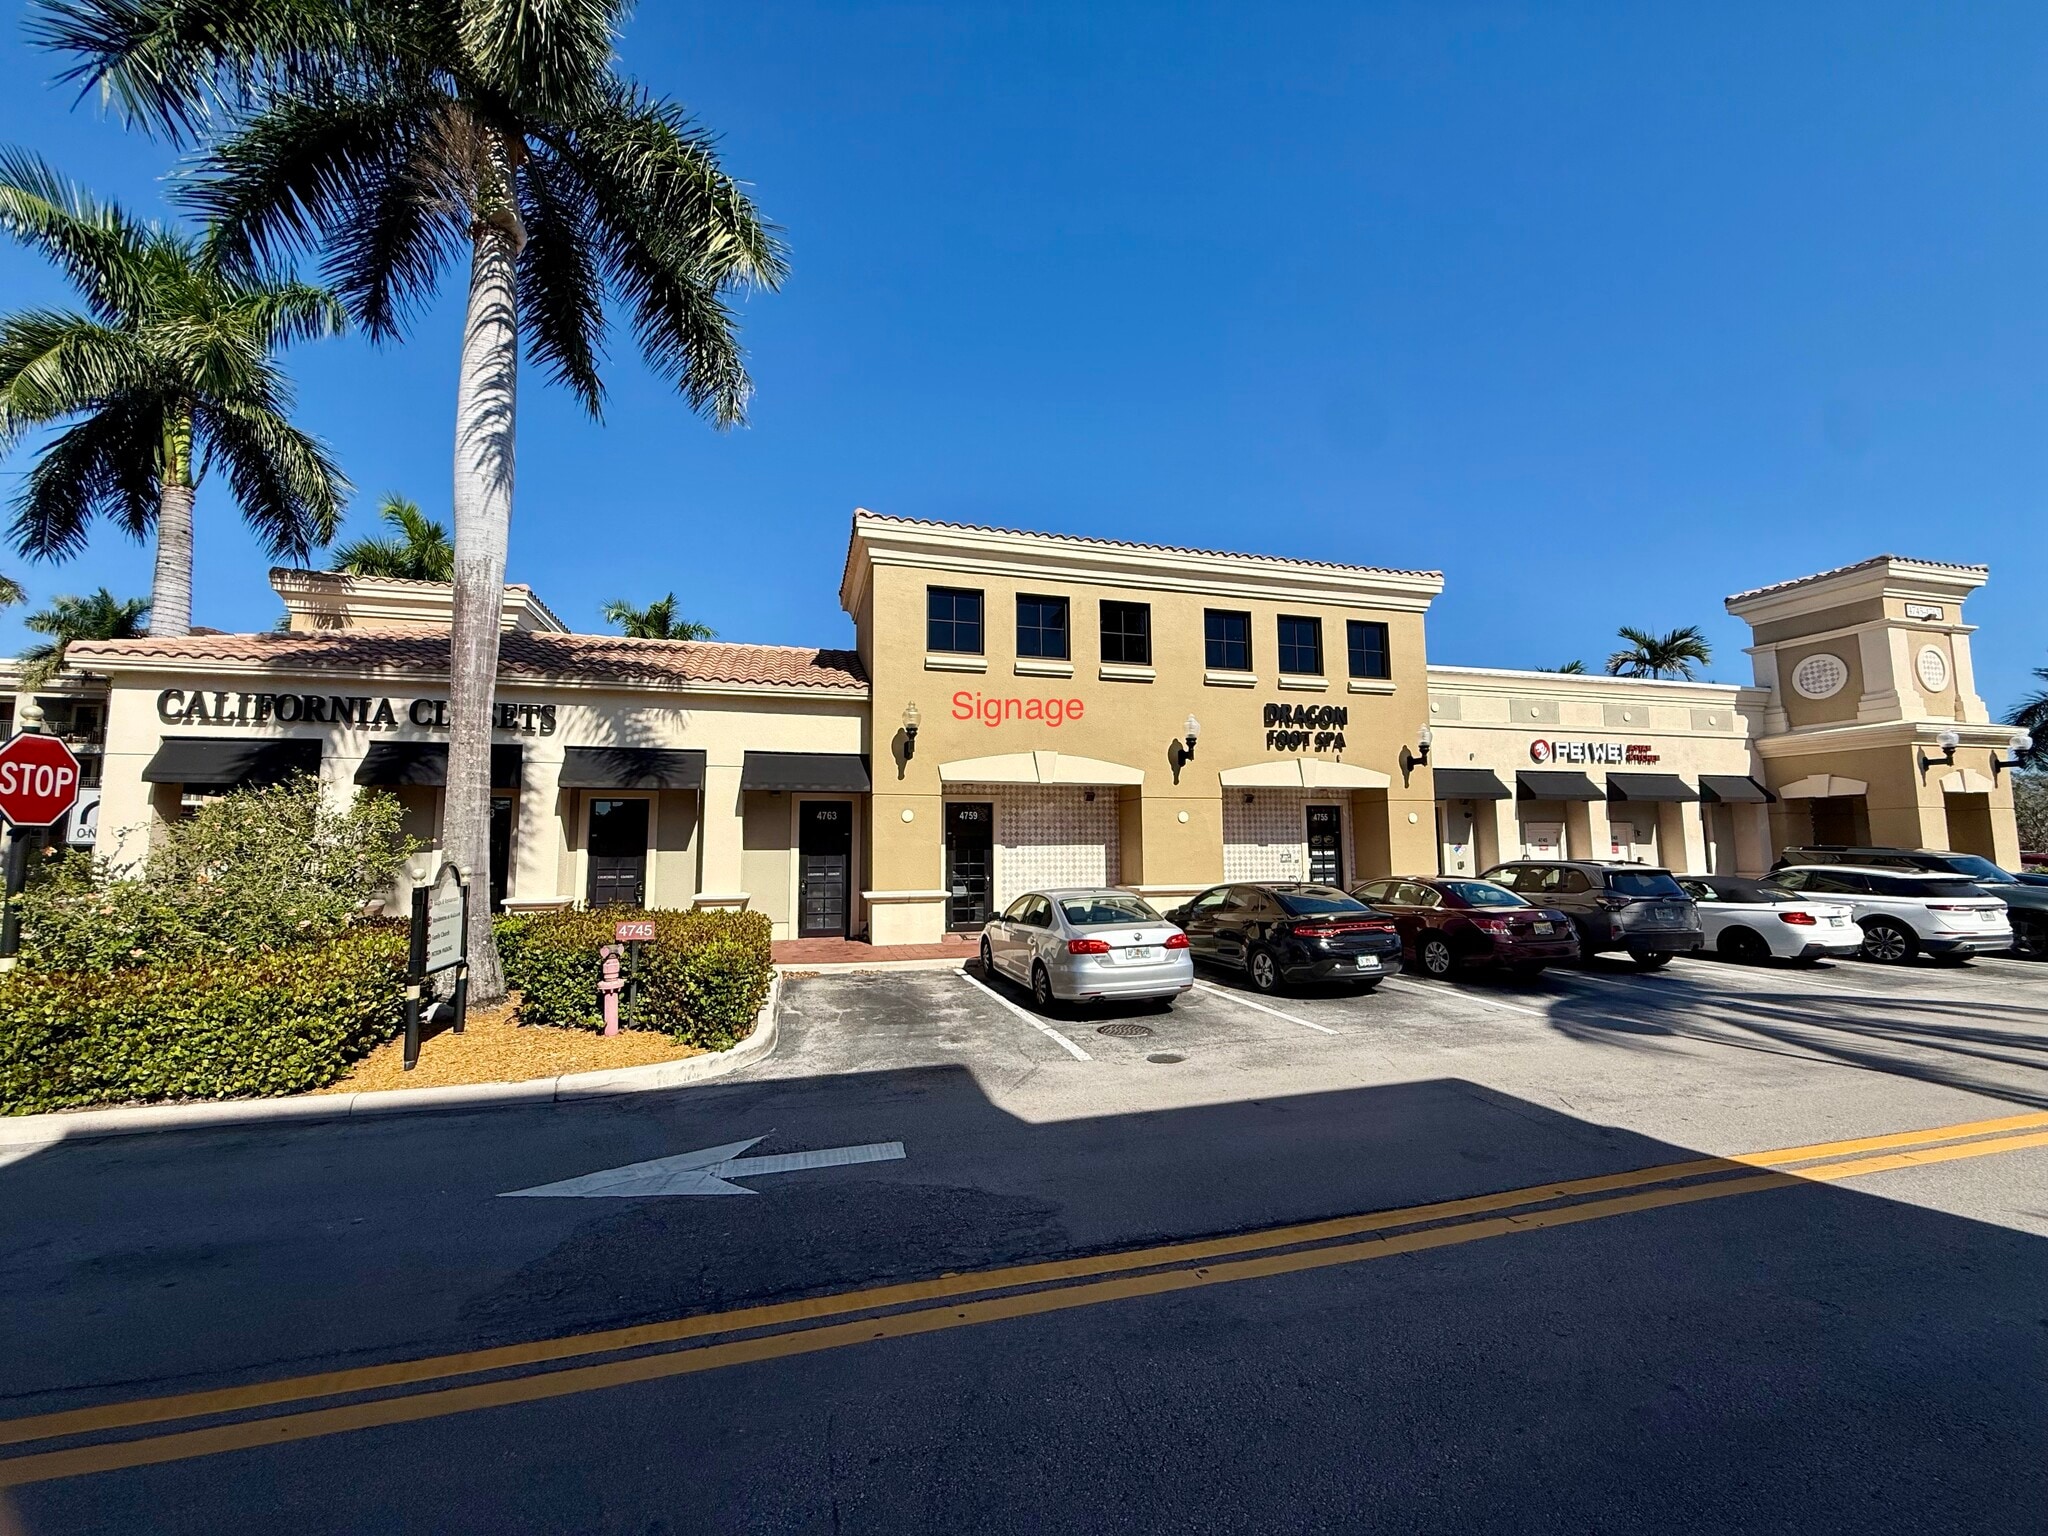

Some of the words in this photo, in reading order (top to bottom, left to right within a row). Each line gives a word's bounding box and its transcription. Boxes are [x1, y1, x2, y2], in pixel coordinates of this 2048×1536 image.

[157, 688, 398, 727] CALIFORNIA
[409, 699, 556, 733] CLETS
[1264, 703, 1347, 729] DRAGON
[1267, 730, 1313, 751] FOOT
[1315, 731, 1346, 752] SPA
[0, 761, 73, 797] STOP
[816, 811, 838, 820] 4763
[959, 811, 978, 820] 4759
[1313, 813, 1328, 821] 4755
[77, 828, 96, 838] ON
[618, 924, 653, 937] 4745
